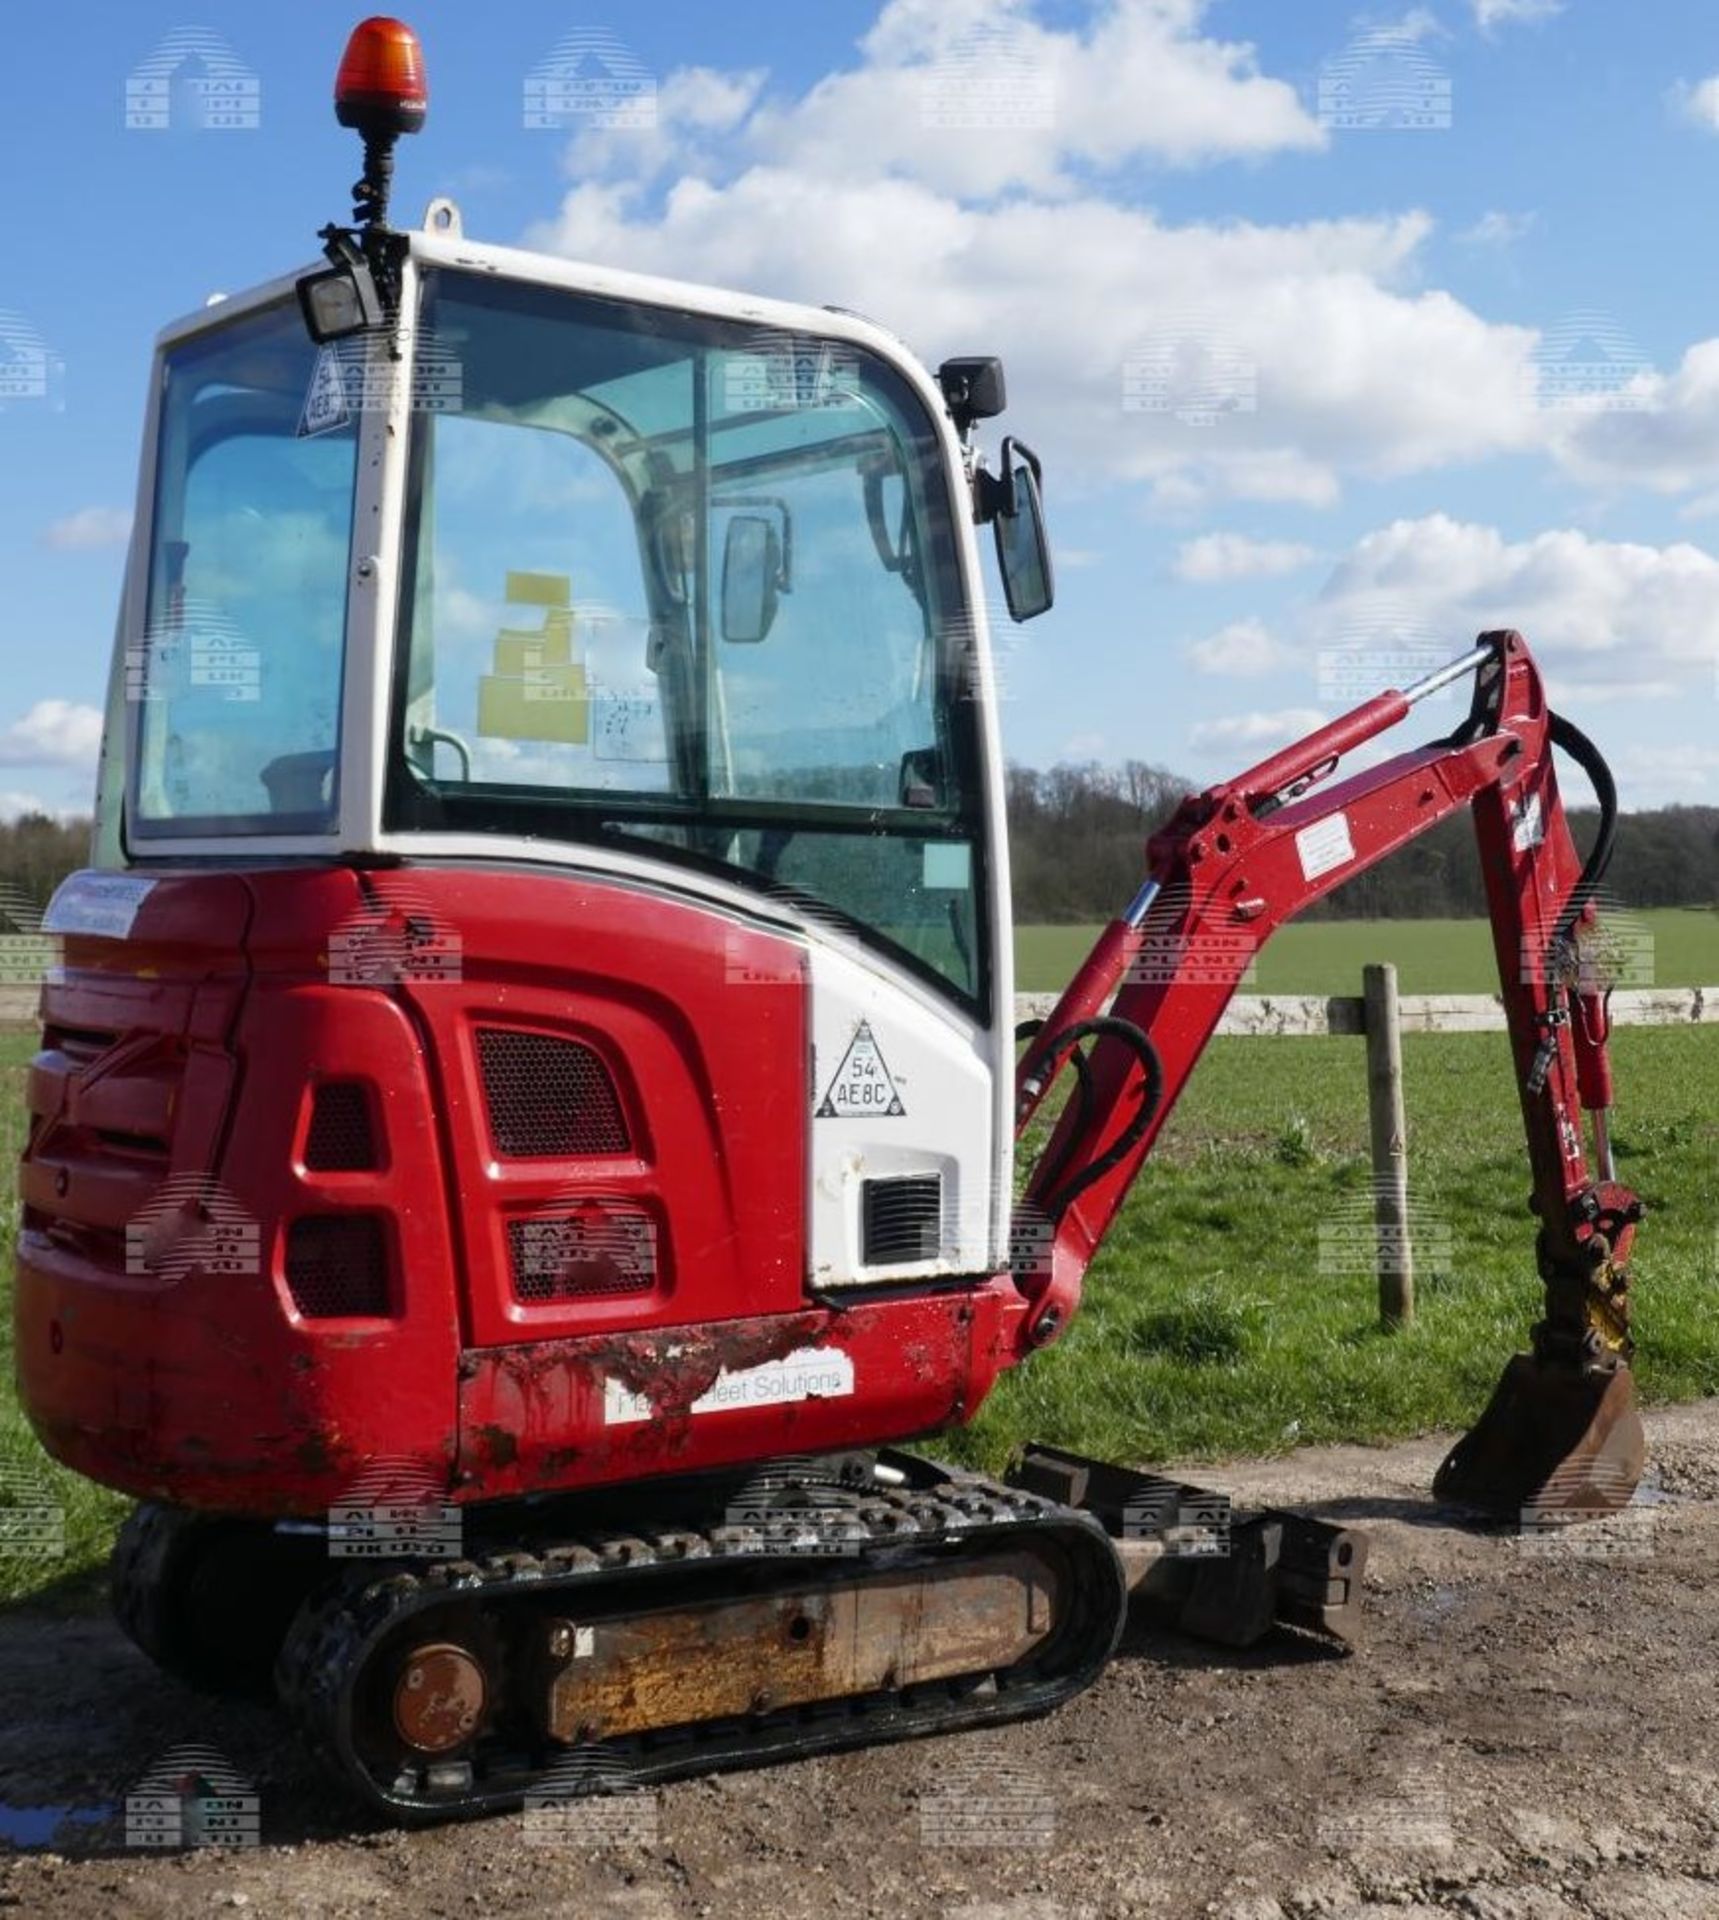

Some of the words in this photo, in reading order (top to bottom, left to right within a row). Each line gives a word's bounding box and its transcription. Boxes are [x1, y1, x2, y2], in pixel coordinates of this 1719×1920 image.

[852, 1057, 877, 1078] 54
[837, 1083, 886, 1105] AE8C
[754, 1370, 842, 1399] Solutions
